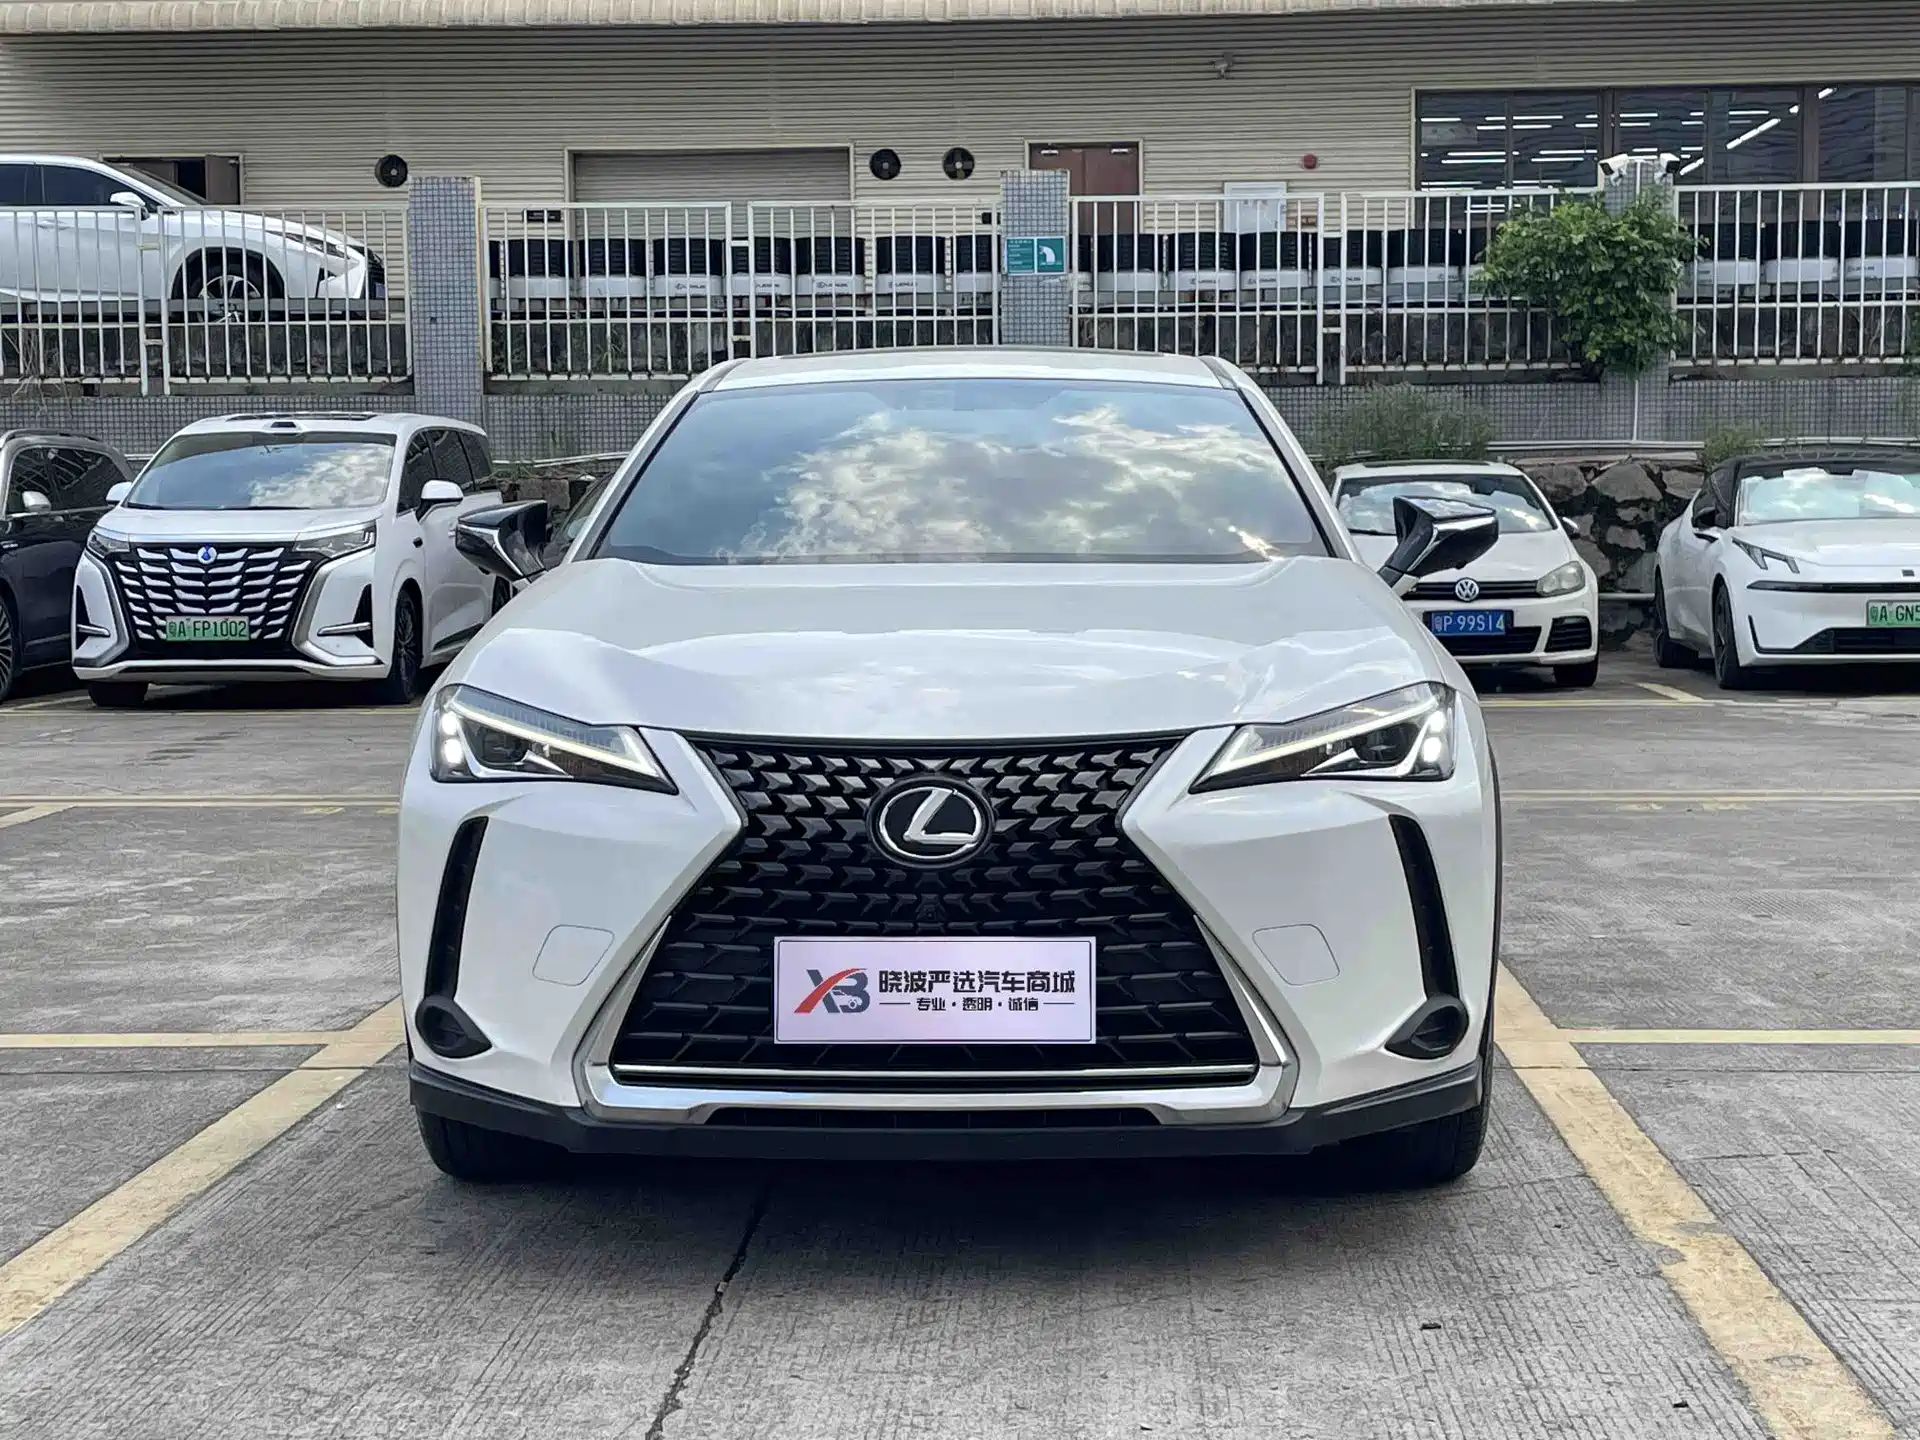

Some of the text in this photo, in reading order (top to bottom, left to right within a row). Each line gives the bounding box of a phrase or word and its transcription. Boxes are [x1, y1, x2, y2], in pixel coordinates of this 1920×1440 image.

[878, 970, 1076, 993] 晓波严选汽车商城
